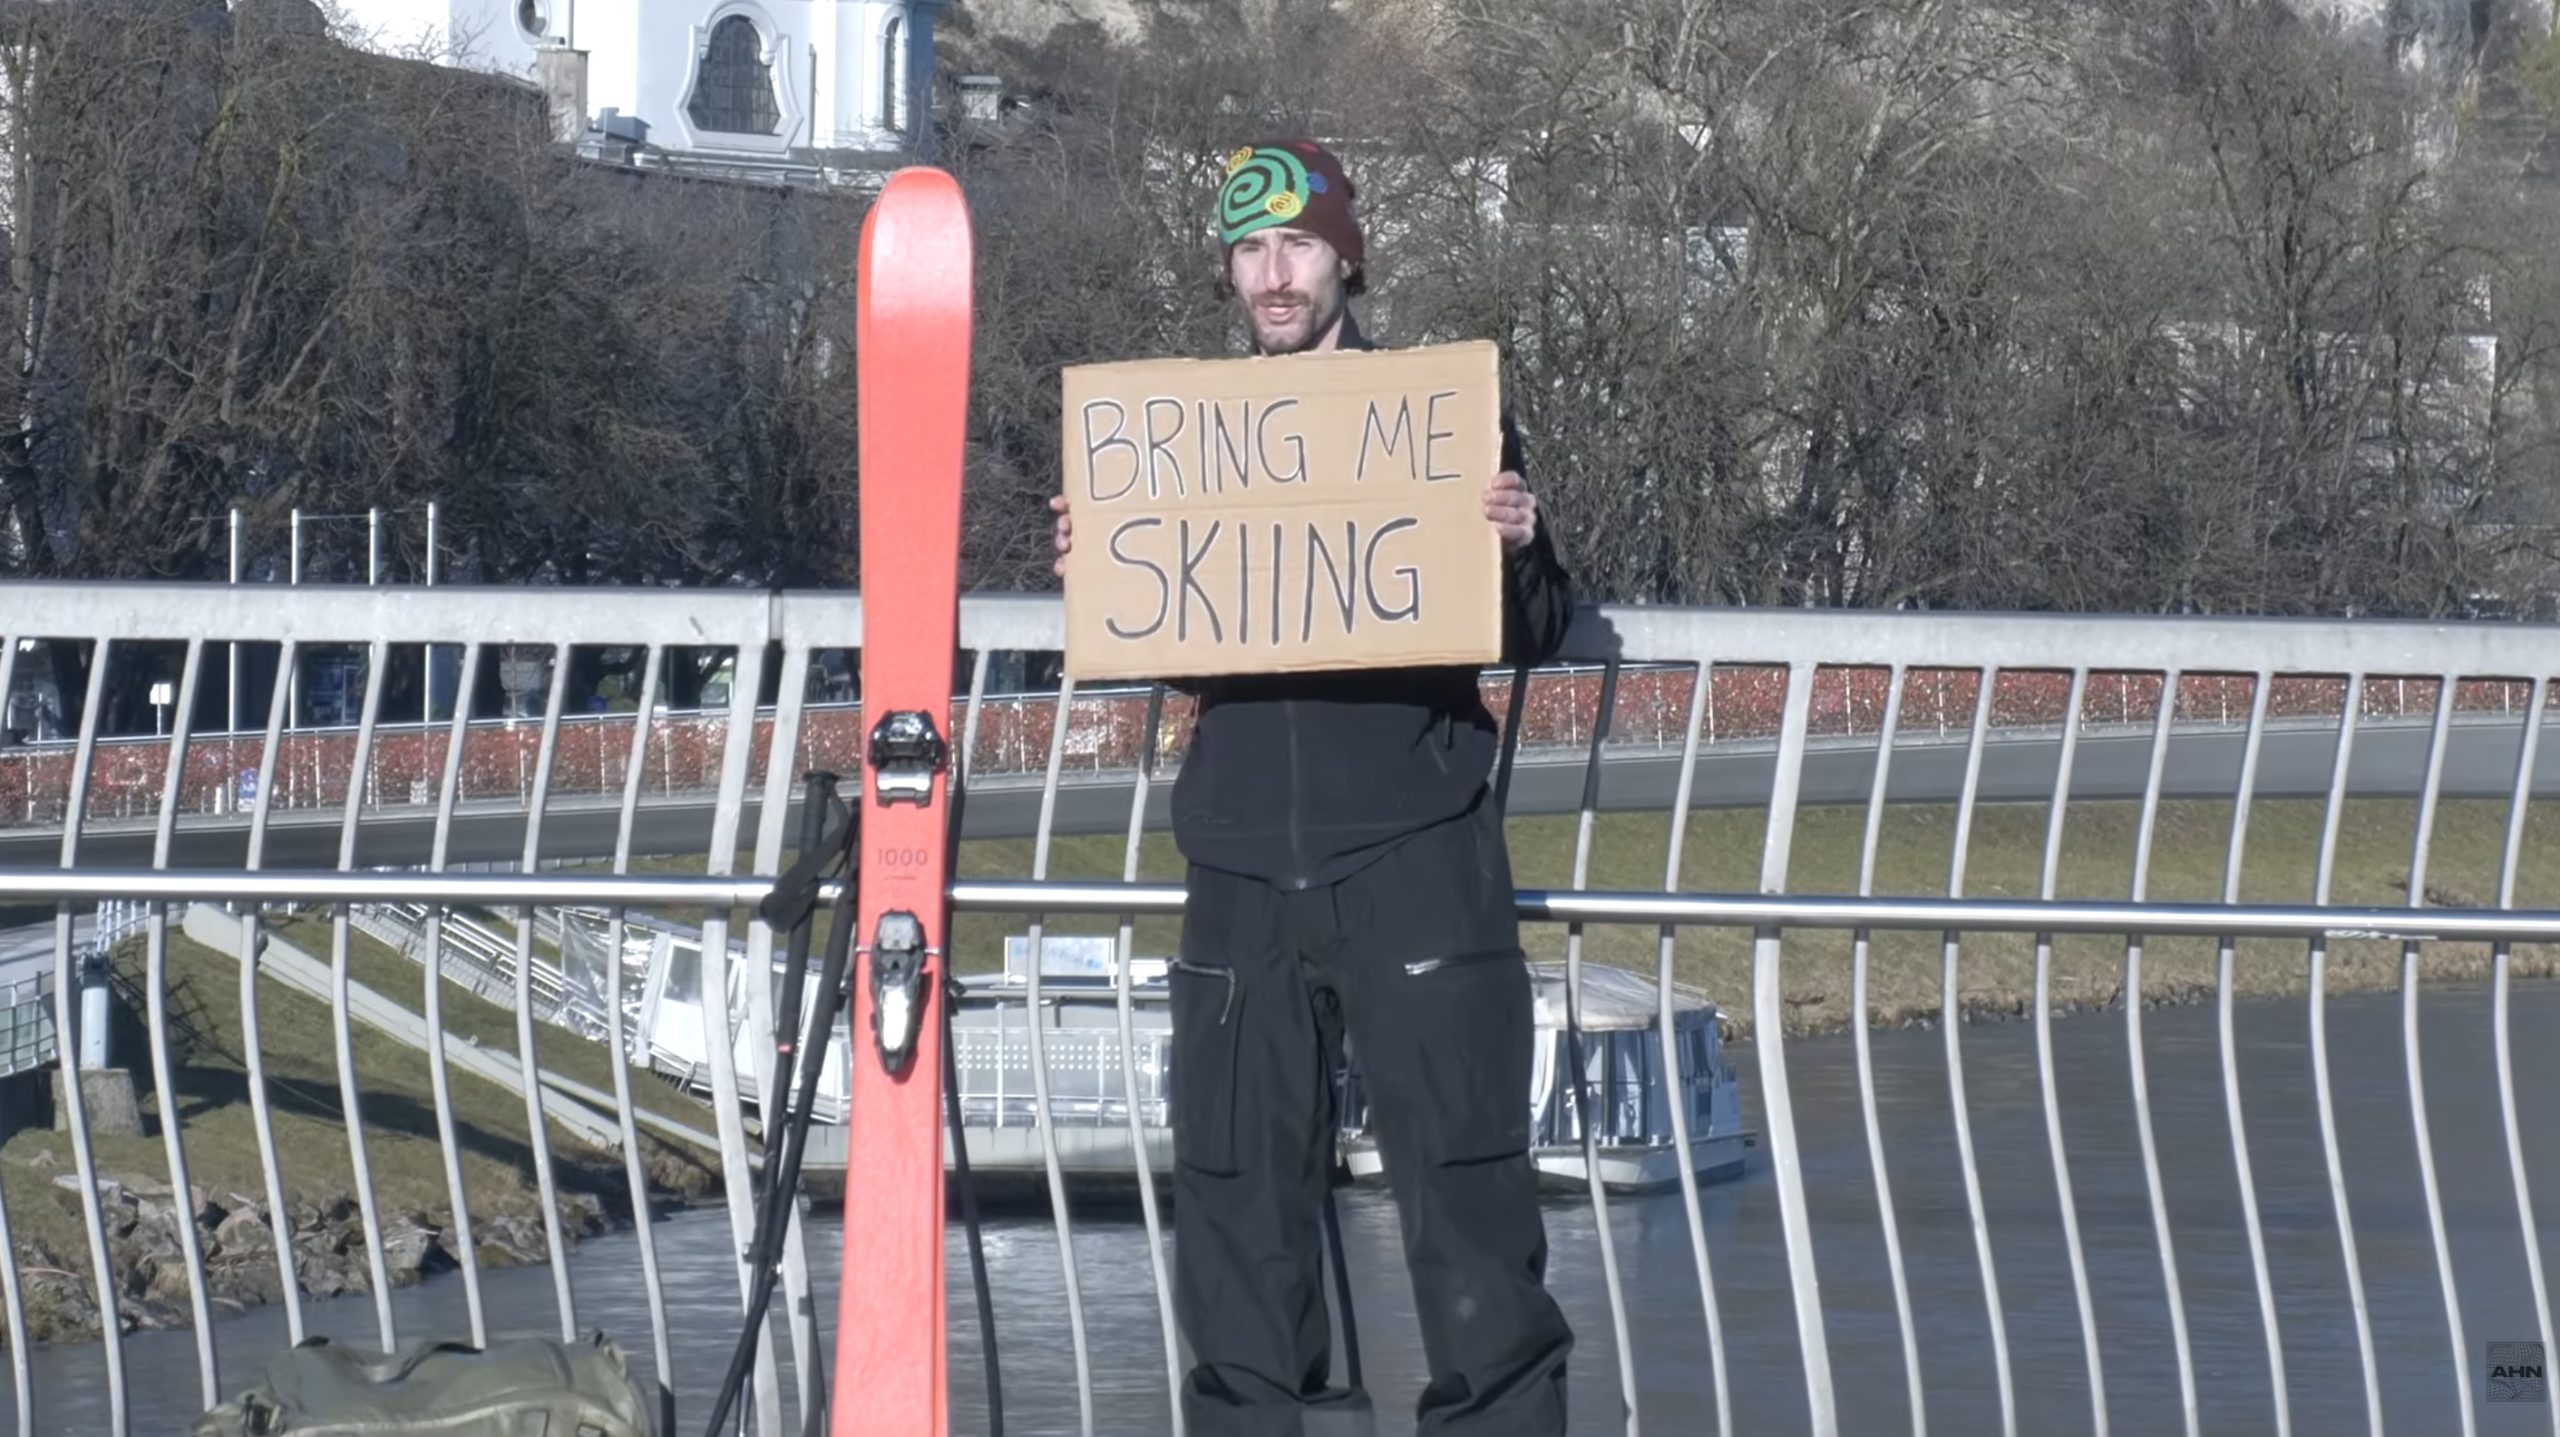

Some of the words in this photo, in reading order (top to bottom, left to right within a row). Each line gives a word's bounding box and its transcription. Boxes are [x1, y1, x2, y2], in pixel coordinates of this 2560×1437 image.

[1083, 397, 1307, 501] BRING
[1356, 390, 1462, 481] ME
[1105, 517, 1420, 645] SKIING
[876, 847, 929, 867] 1000
